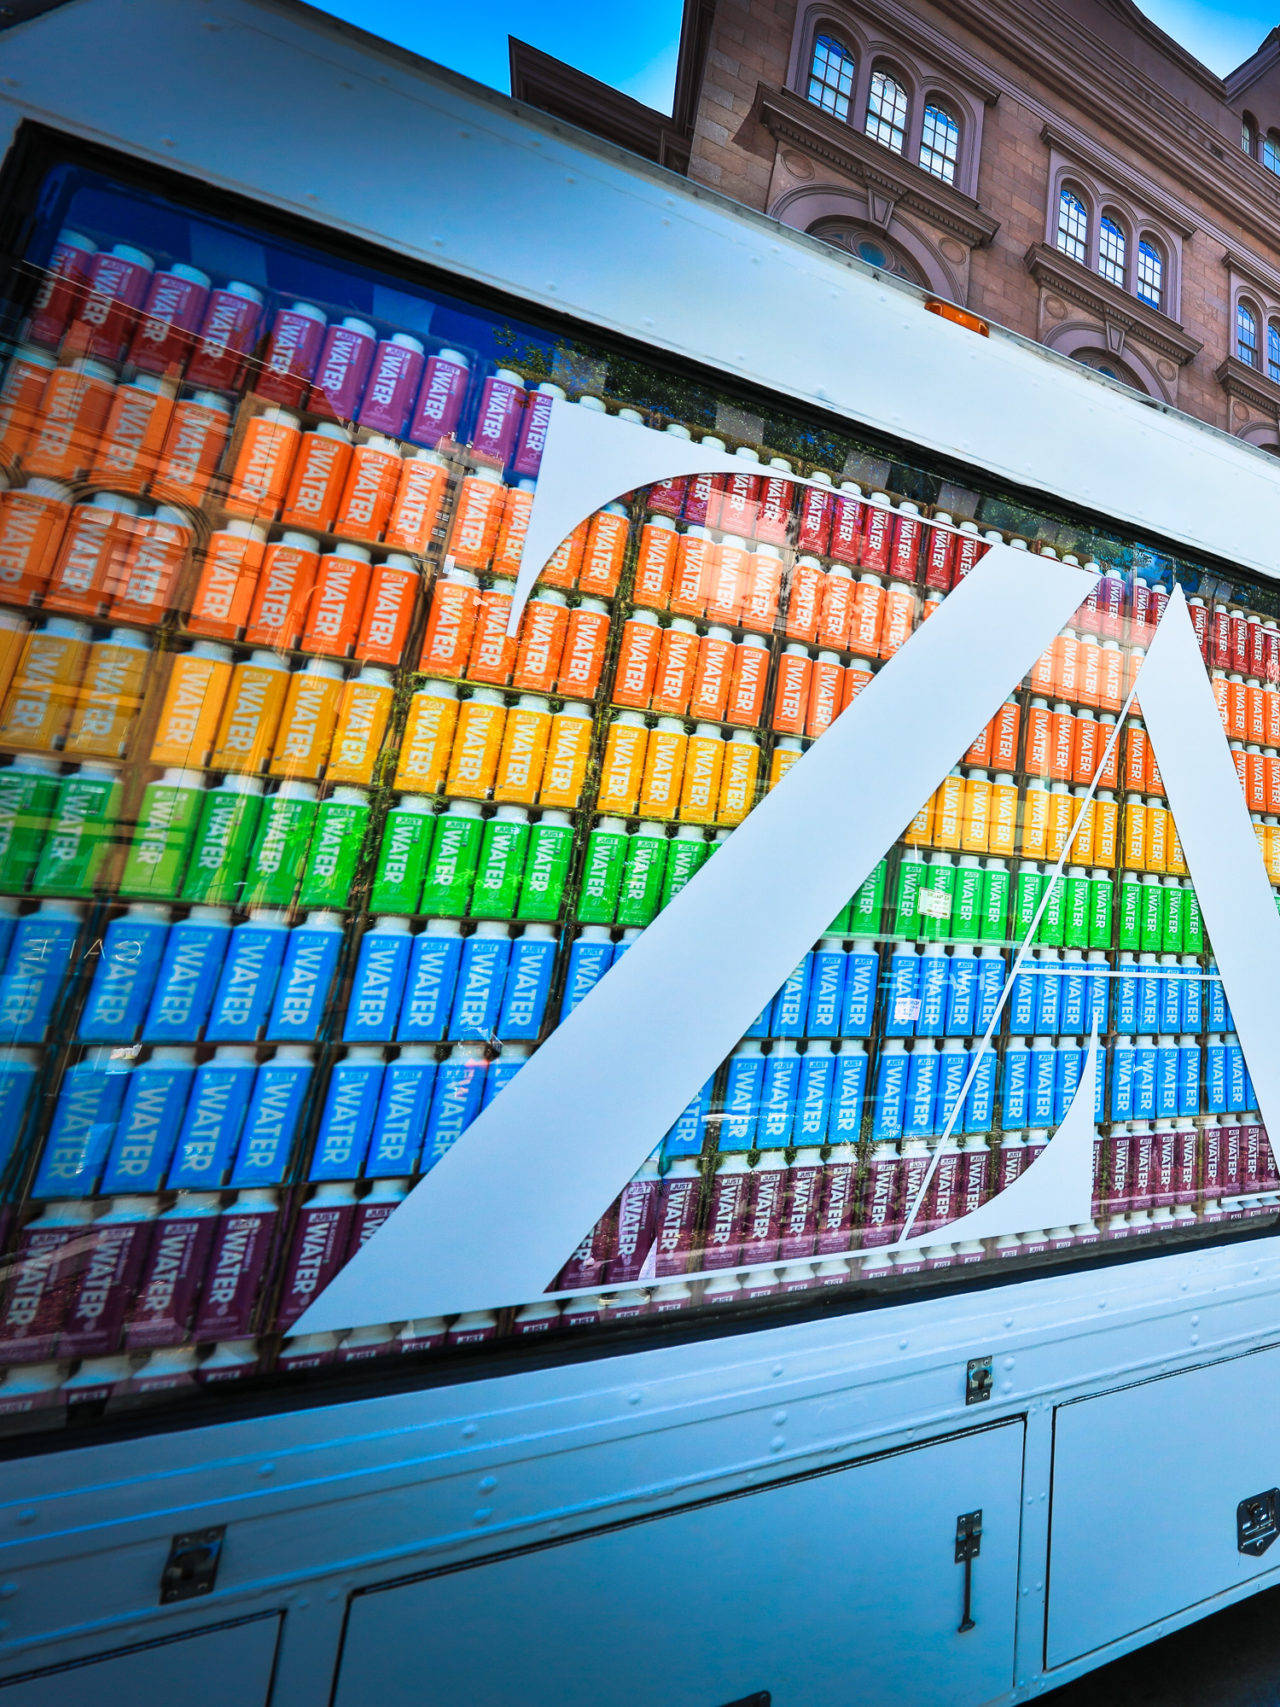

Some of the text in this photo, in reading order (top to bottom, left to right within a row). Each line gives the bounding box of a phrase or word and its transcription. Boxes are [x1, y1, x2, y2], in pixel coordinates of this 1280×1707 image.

[82, 268, 115, 324] WATER
[202, 306, 234, 358] WATER
[268, 324, 298, 375] WATER
[322, 340, 351, 390] WATER
[424, 371, 452, 420] WATER
[482, 391, 509, 438] WATER
[167, 415, 212, 484] WATER
[526, 402, 551, 449] WATER
[240, 436, 281, 499] WATER
[399, 474, 432, 533] WATER
[460, 490, 492, 550] WATER
[800, 491, 825, 536] WATER
[642, 538, 670, 592] WATER
[899, 521, 914, 560] WATER
[933, 530, 948, 568] WATER
[202, 552, 245, 618] WATER
[717, 554, 742, 609] WATER
[795, 573, 818, 626] WATER
[368, 582, 403, 647] WATER
[430, 597, 464, 660] WATER
[1219, 618, 1229, 652] WATER
[520, 614, 554, 674] WATER
[625, 633, 652, 695] WATER
[1063, 644, 1078, 690] WATER
[168, 669, 212, 744] WATER
[737, 654, 762, 715] WATER
[227, 679, 270, 754] WATER
[339, 697, 375, 765] WATER
[407, 706, 441, 776] WATER
[1032, 713, 1049, 768] WATER
[1253, 695, 1263, 735] WATER
[550, 729, 579, 791] WATER
[608, 739, 636, 796] WATER
[690, 748, 716, 807] WATER
[1080, 725, 1095, 777] WATER
[1131, 737, 1143, 783] WATER
[1253, 761, 1264, 800] WATER
[1271, 765, 1280, 804] WATER
[50, 797, 87, 860] WATER
[199, 807, 234, 869] WATER
[313, 818, 346, 876] WATER
[384, 828, 412, 883] WATER
[1102, 810, 1115, 856] WATER
[483, 835, 510, 889] WATER
[530, 839, 556, 891] WATER
[586, 846, 610, 898] WATER
[1271, 837, 1280, 877] WATER
[960, 878, 978, 921] WATER
[988, 880, 1005, 923] WATER
[158, 944, 203, 1025] WATER
[357, 951, 395, 1025] WATER
[509, 955, 541, 1025] WATER
[803, 1069, 827, 1133] WATER
[913, 1065, 933, 1125] WATER
[973, 1063, 992, 1121] WATER
[1009, 1061, 1025, 1118] WATER
[1117, 1059, 1134, 1111] WATER
[1213, 1056, 1225, 1104] WATER
[117, 1087, 169, 1177] WATER
[245, 1083, 291, 1169] WATER
[1115, 1146, 1128, 1191] WATER
[1161, 1141, 1173, 1184] WATER
[1228, 1135, 1240, 1176] WATER
[618, 1194, 647, 1255] WATER
[661, 1190, 685, 1250] WATER
[752, 1182, 775, 1239] WATER
[791, 1178, 811, 1232] WATER
[871, 1171, 893, 1224] WATER
[144, 1234, 194, 1312] WATER
[209, 1229, 256, 1303] WATER
[292, 1223, 328, 1294] WATER
